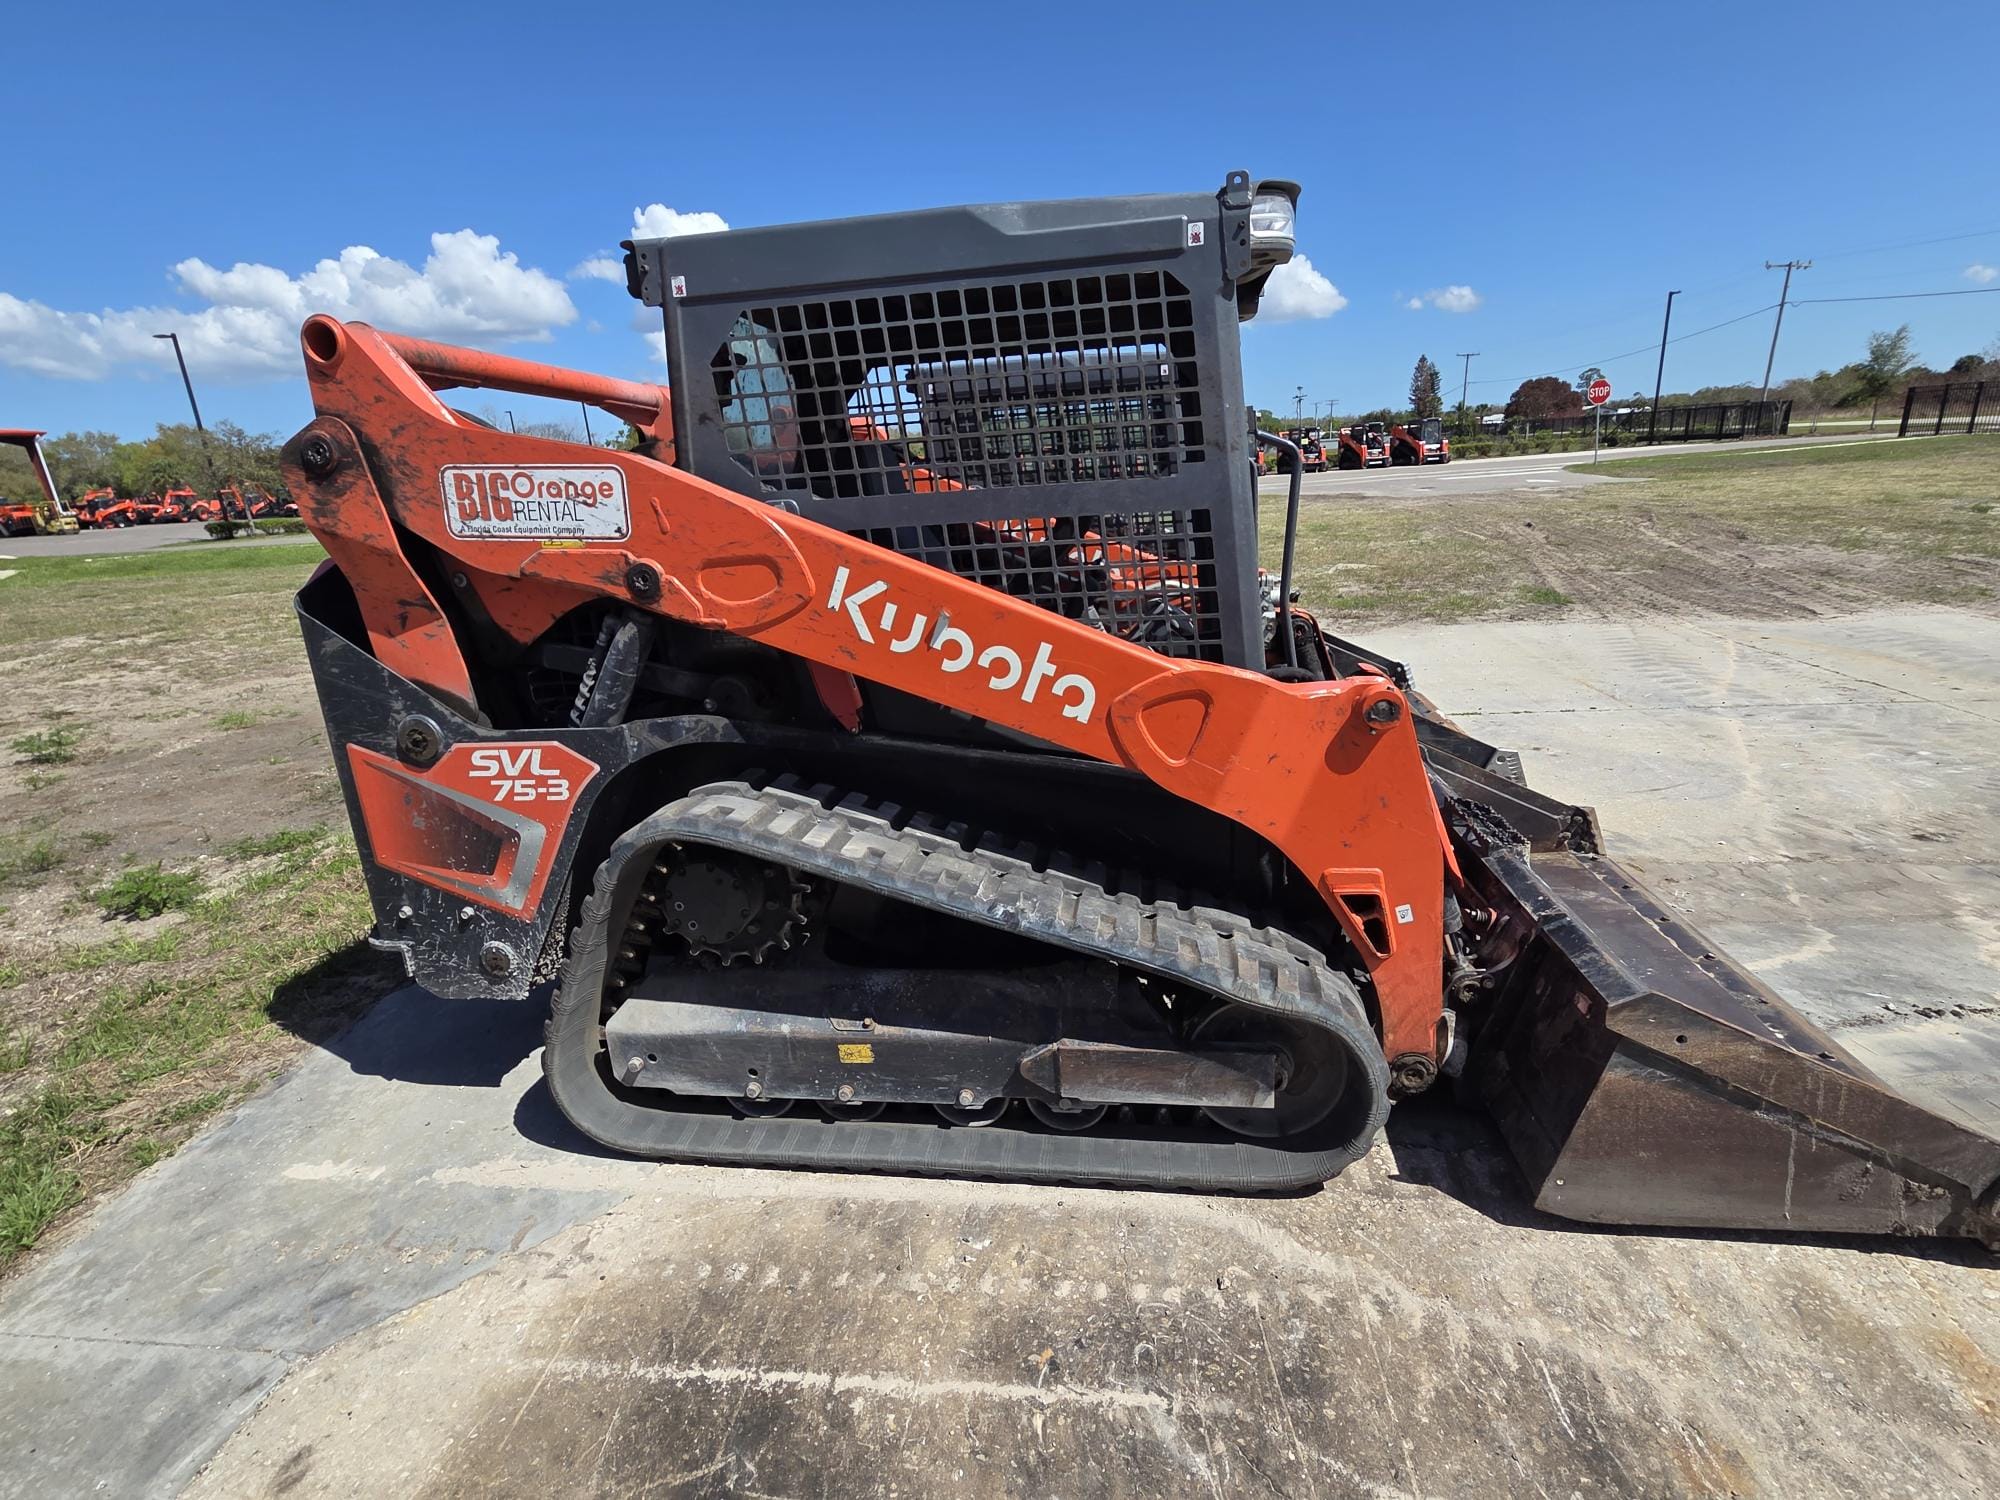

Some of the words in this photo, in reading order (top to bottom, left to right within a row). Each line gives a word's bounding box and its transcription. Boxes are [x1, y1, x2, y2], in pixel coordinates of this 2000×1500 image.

[1590, 386, 1610, 398] STOP
[453, 472, 514, 522] BIG
[510, 471, 614, 508] Orange
[515, 500, 585, 522] RENTAL
[492, 525, 512, 534] Coast
[514, 526, 551, 535] Equipment
[552, 526, 585, 536] Company
[827, 566, 1096, 724] Kubota
[469, 748, 560, 777] SVL
[490, 779, 570, 802] 75-3
